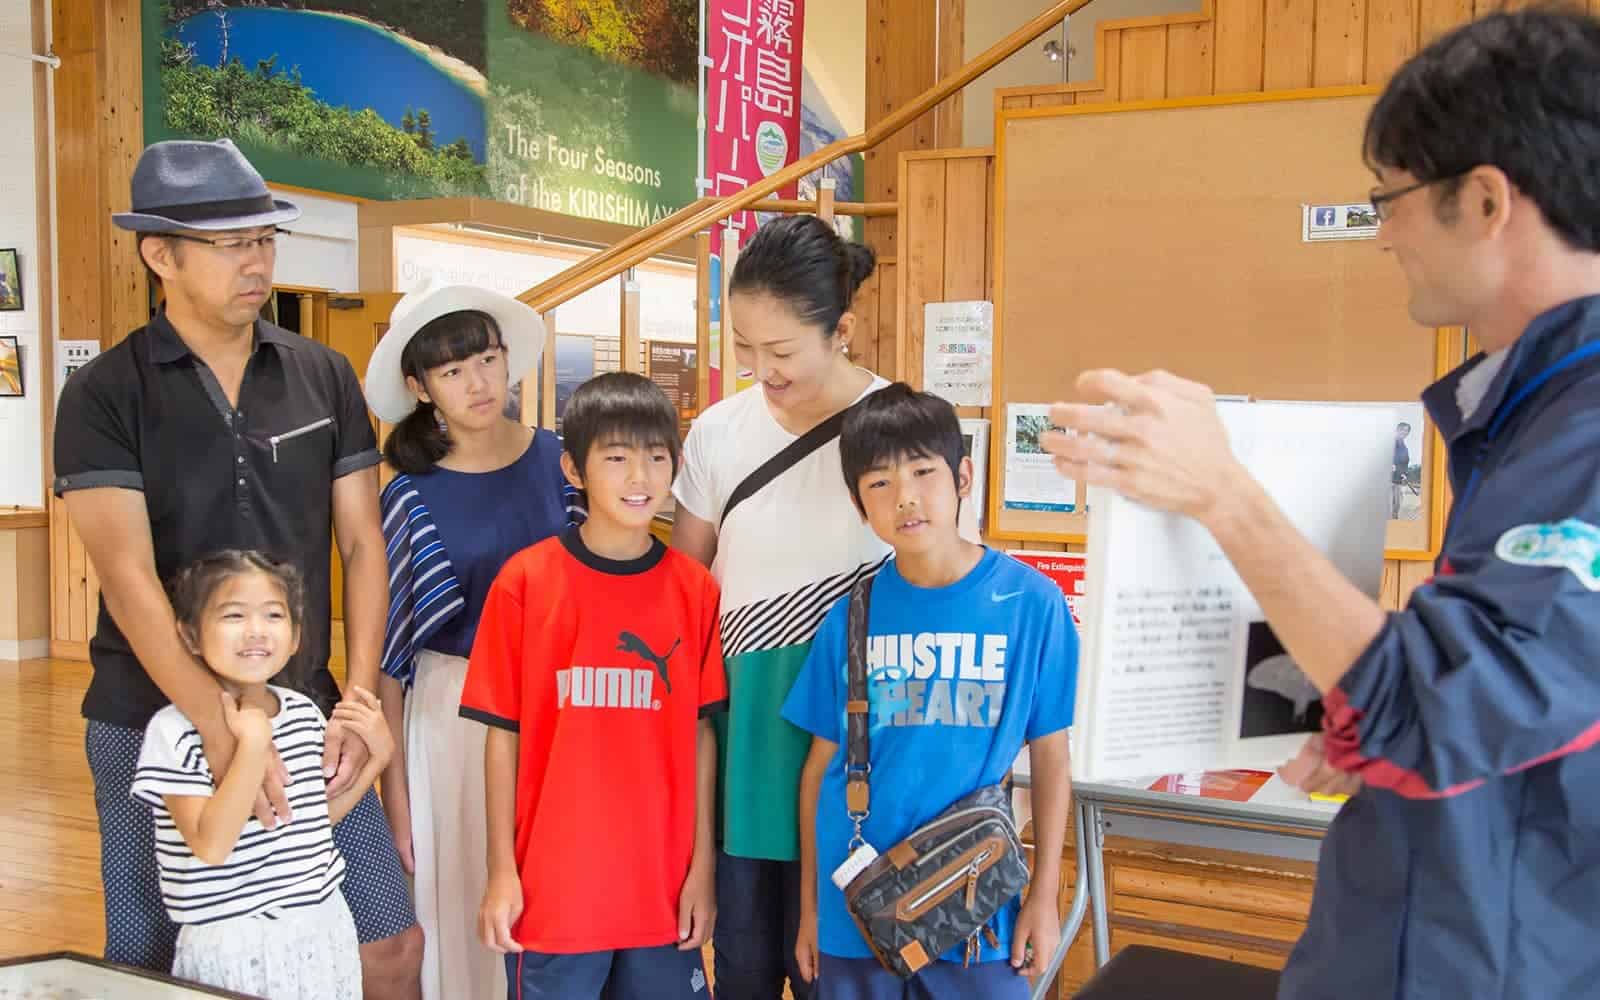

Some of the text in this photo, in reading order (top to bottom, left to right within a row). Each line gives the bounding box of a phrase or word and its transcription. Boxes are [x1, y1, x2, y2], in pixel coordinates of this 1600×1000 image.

[506, 122, 661, 187] The Four Seasons
[507, 175, 526, 202] of
[532, 176, 561, 210] the
[866, 632, 1008, 680] HUSTLE
[556, 666, 654, 709] PUMA
[876, 680, 1007, 728] HEART
